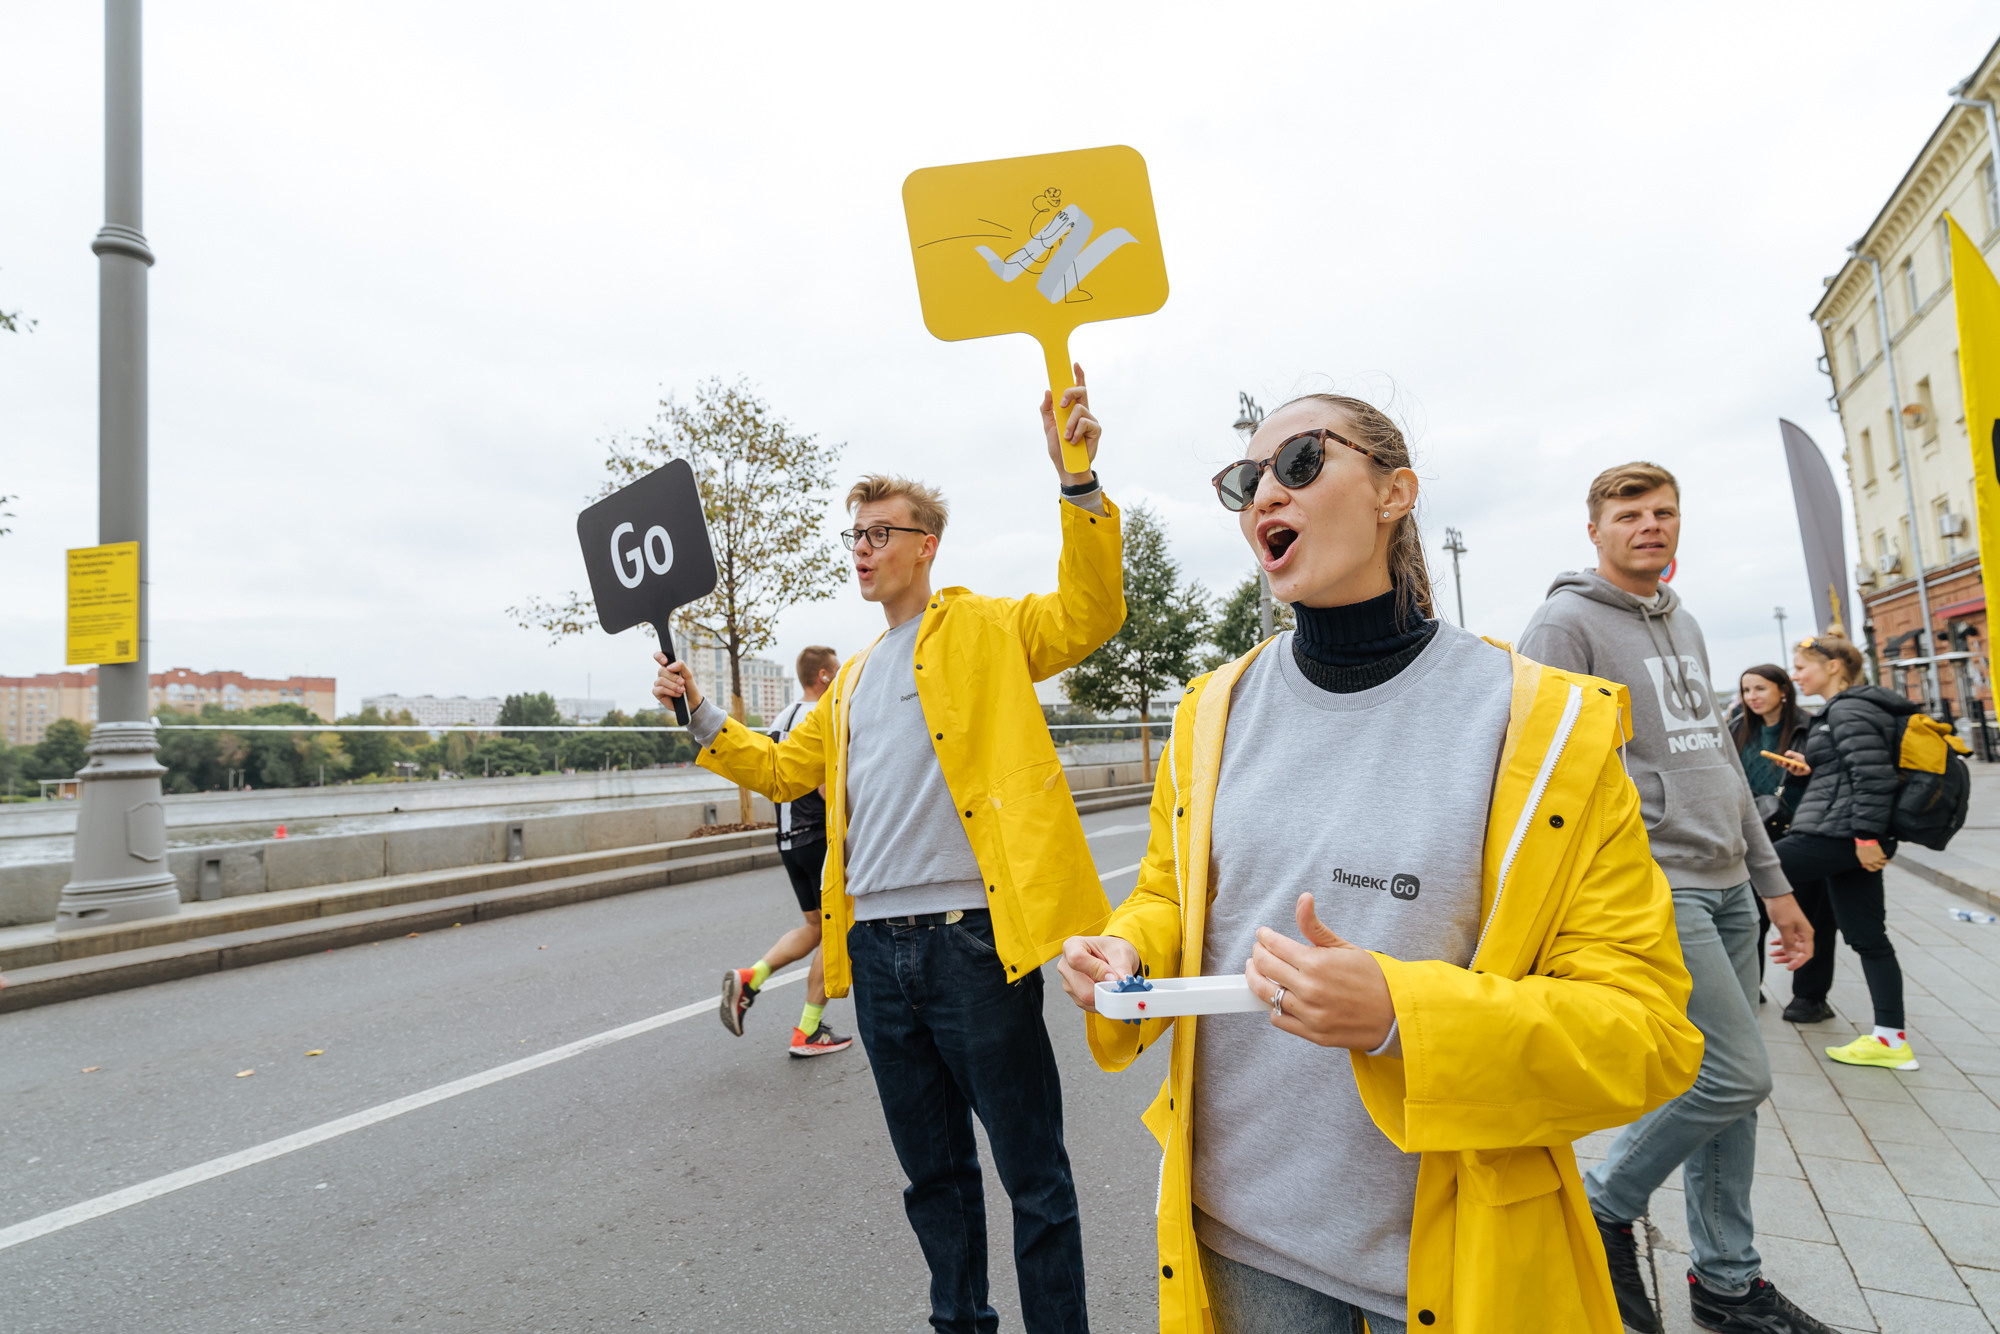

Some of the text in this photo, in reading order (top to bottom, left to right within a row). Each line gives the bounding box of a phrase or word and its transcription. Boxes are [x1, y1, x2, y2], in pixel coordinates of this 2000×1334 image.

[610, 521, 674, 589] Go
[1332, 868, 1416, 896] Яндекс Go
[818, 1033, 831, 1045] N
